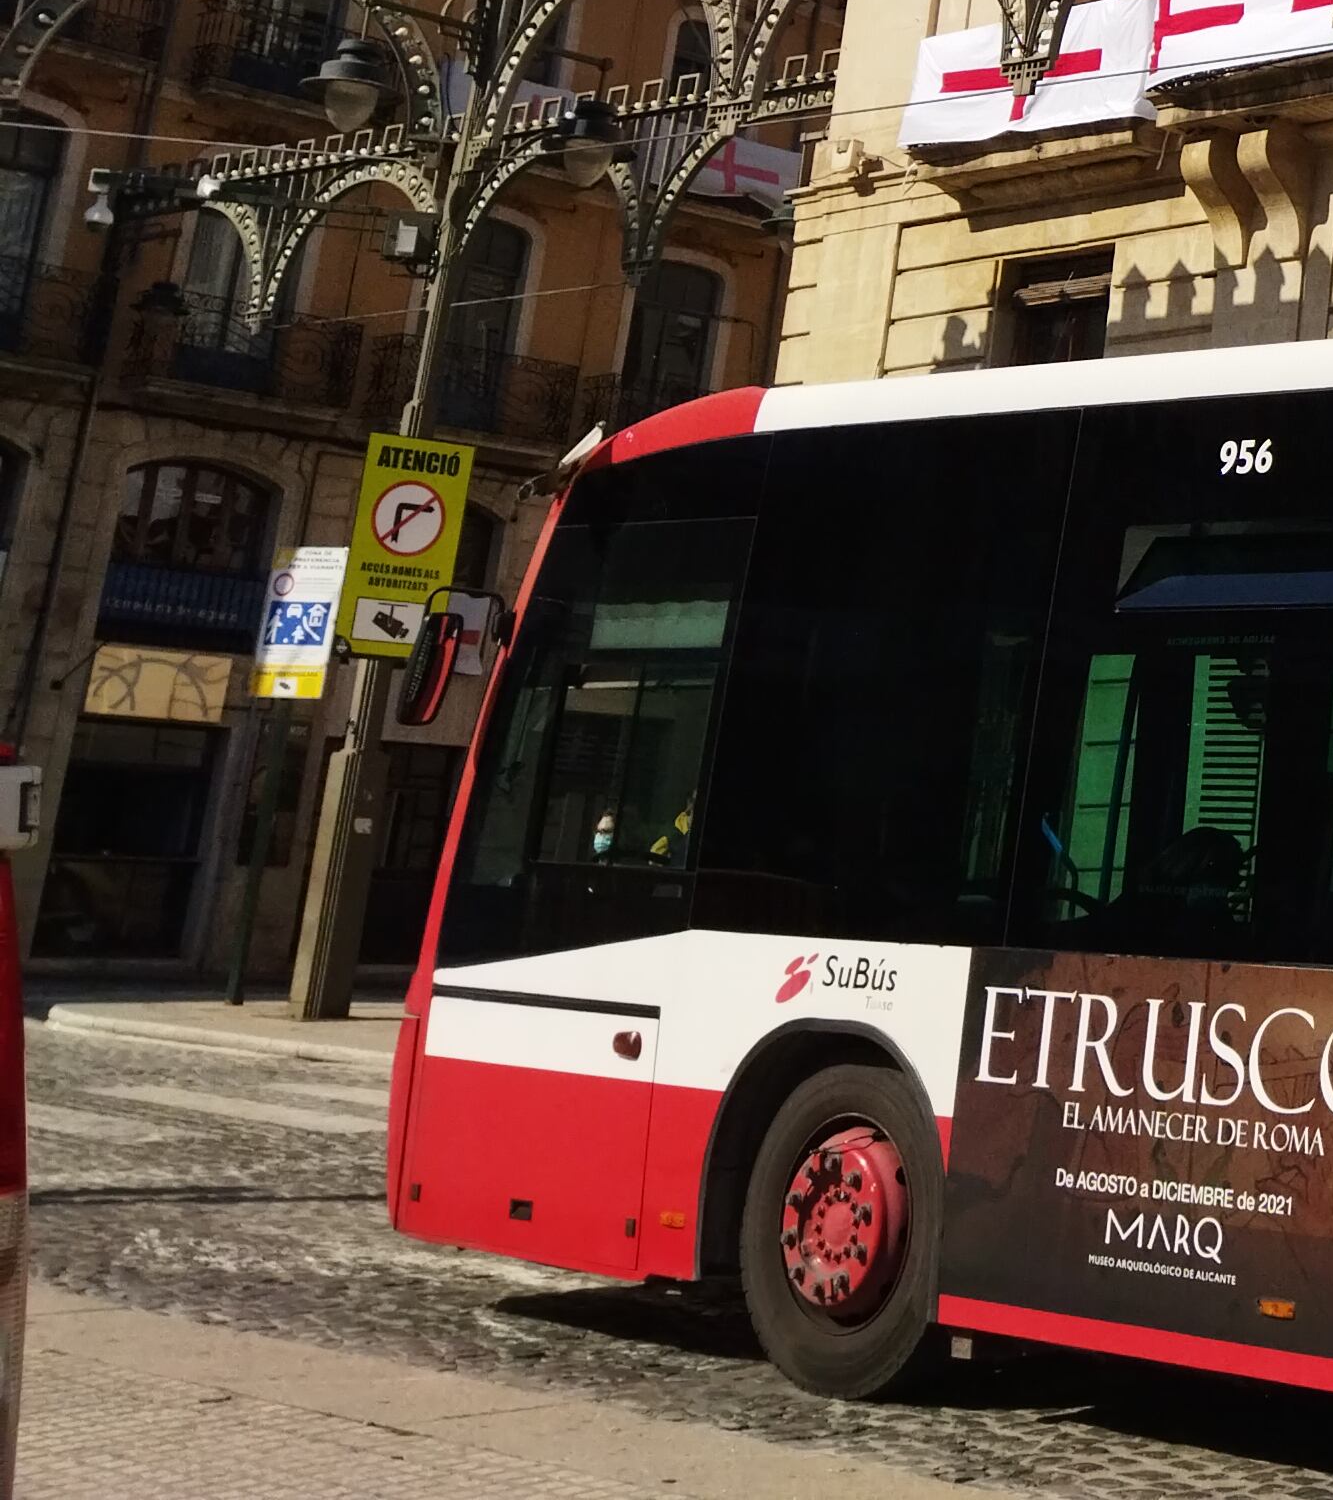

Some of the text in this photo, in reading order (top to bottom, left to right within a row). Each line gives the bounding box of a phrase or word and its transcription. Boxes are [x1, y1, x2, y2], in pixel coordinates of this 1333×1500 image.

[377, 445, 461, 477] ATENCIÓ
[1219, 438, 1273, 475] 956
[368, 576, 428, 592] AUTORITZATS
[822, 955, 898, 991] SuBús
[1062, 1101, 1325, 1156] EL AMANECER DE ROMA
[1055, 1168, 1293, 1216] De AGOSTO a DICIEMBRE de 2021
[1104, 1208, 1222, 1264] MARQ
[1088, 1254, 1237, 1286] MUSEO ARQUEOLÓGICO DE ALICANTE
